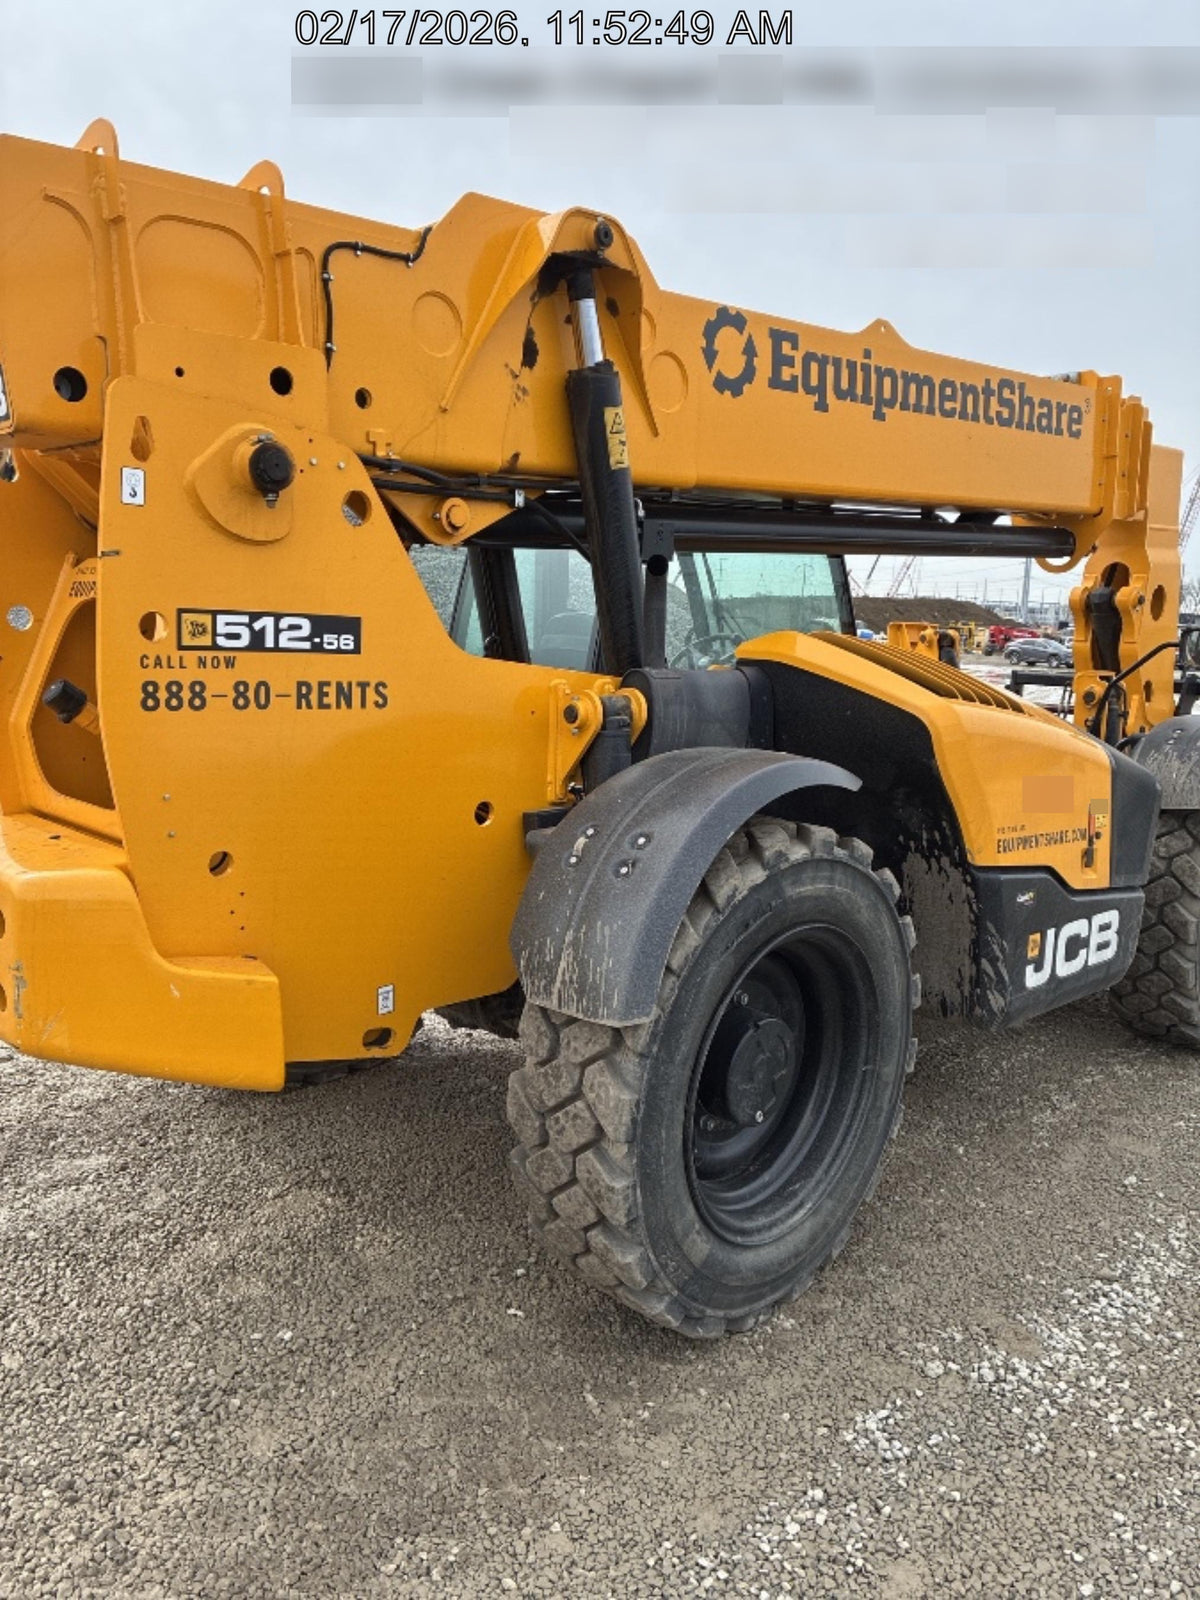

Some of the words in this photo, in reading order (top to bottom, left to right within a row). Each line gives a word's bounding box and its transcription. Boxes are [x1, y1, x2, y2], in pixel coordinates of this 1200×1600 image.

[767, 326, 1083, 439] EquipmentShare
[139, 653, 188, 670] CALL
[197, 654, 237, 670] NOW
[139, 680, 389, 712] 888-80-RENTS
[1025, 909, 1120, 989] JCB
